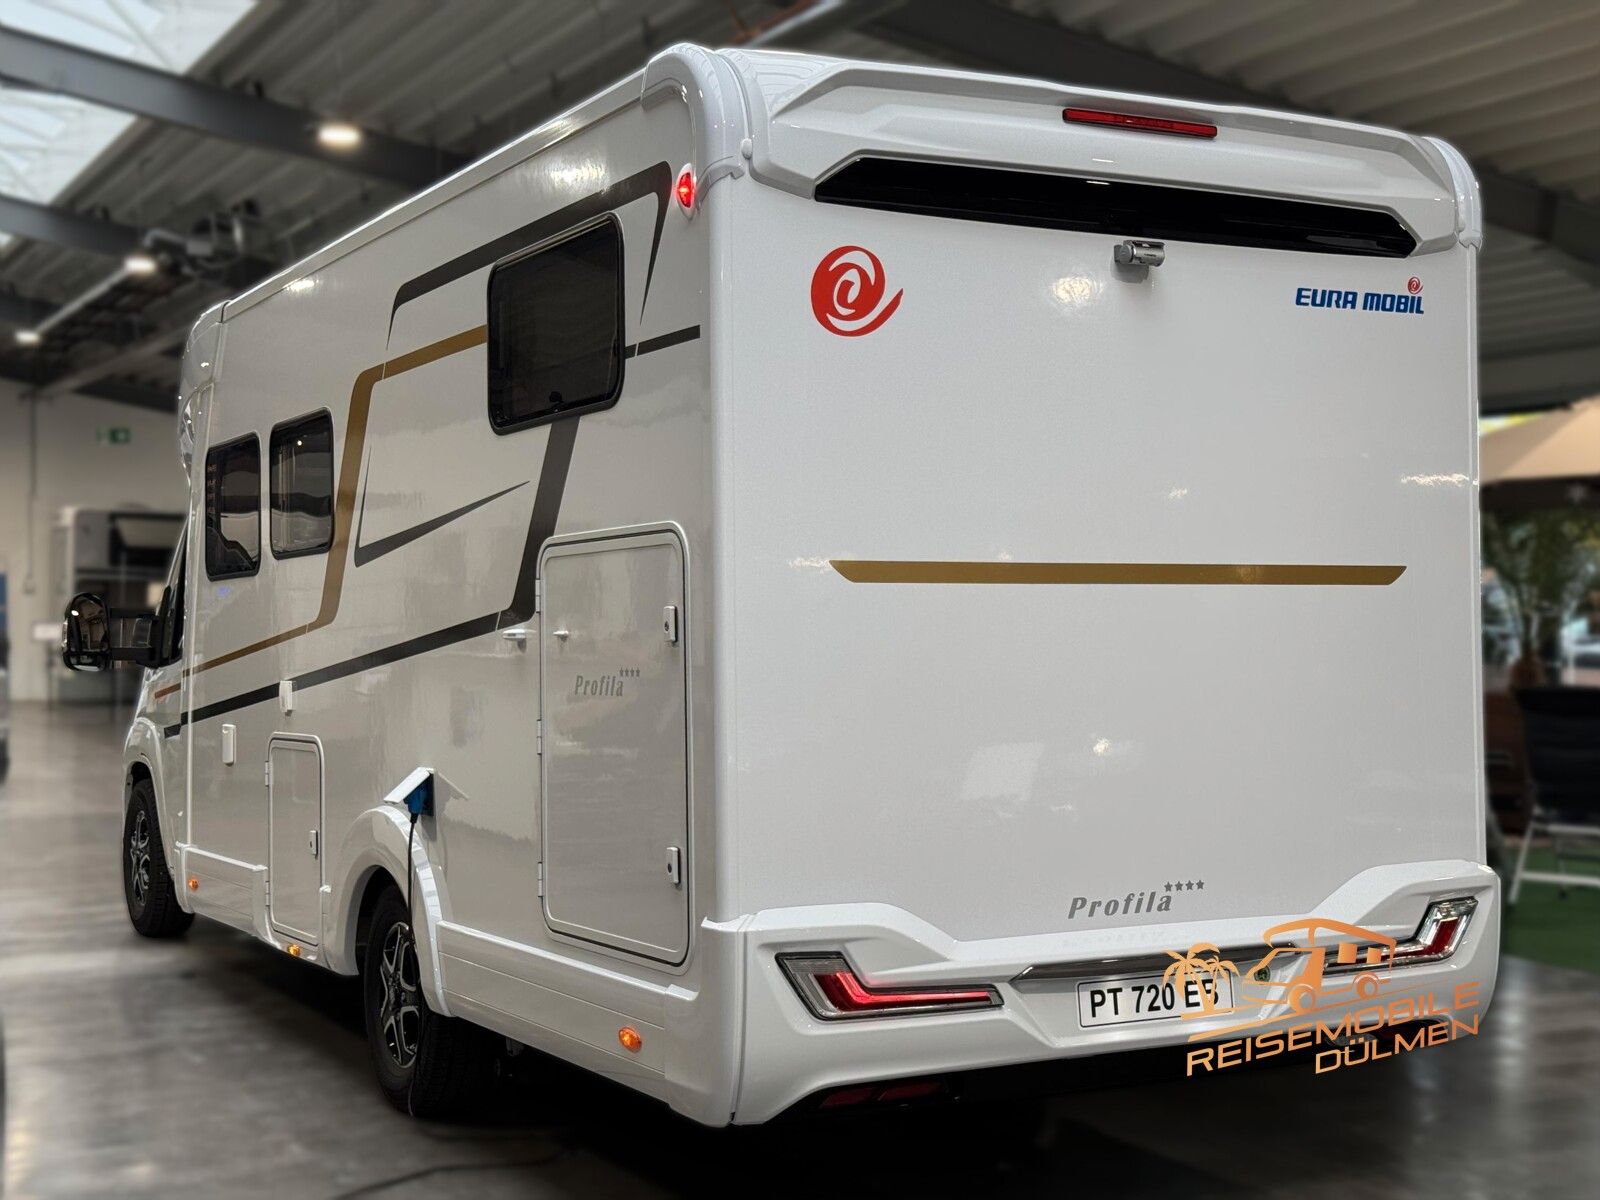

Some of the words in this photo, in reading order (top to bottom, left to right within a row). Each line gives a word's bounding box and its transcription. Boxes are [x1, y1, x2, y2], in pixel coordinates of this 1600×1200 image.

[1295, 287, 1358, 309] EURA
[1362, 292, 1424, 315] MOBIL
[574, 675, 624, 697] Profila
[1068, 891, 1172, 920] Profila
[1090, 987, 1123, 1018] PT
[1131, 982, 1176, 1013] 720
